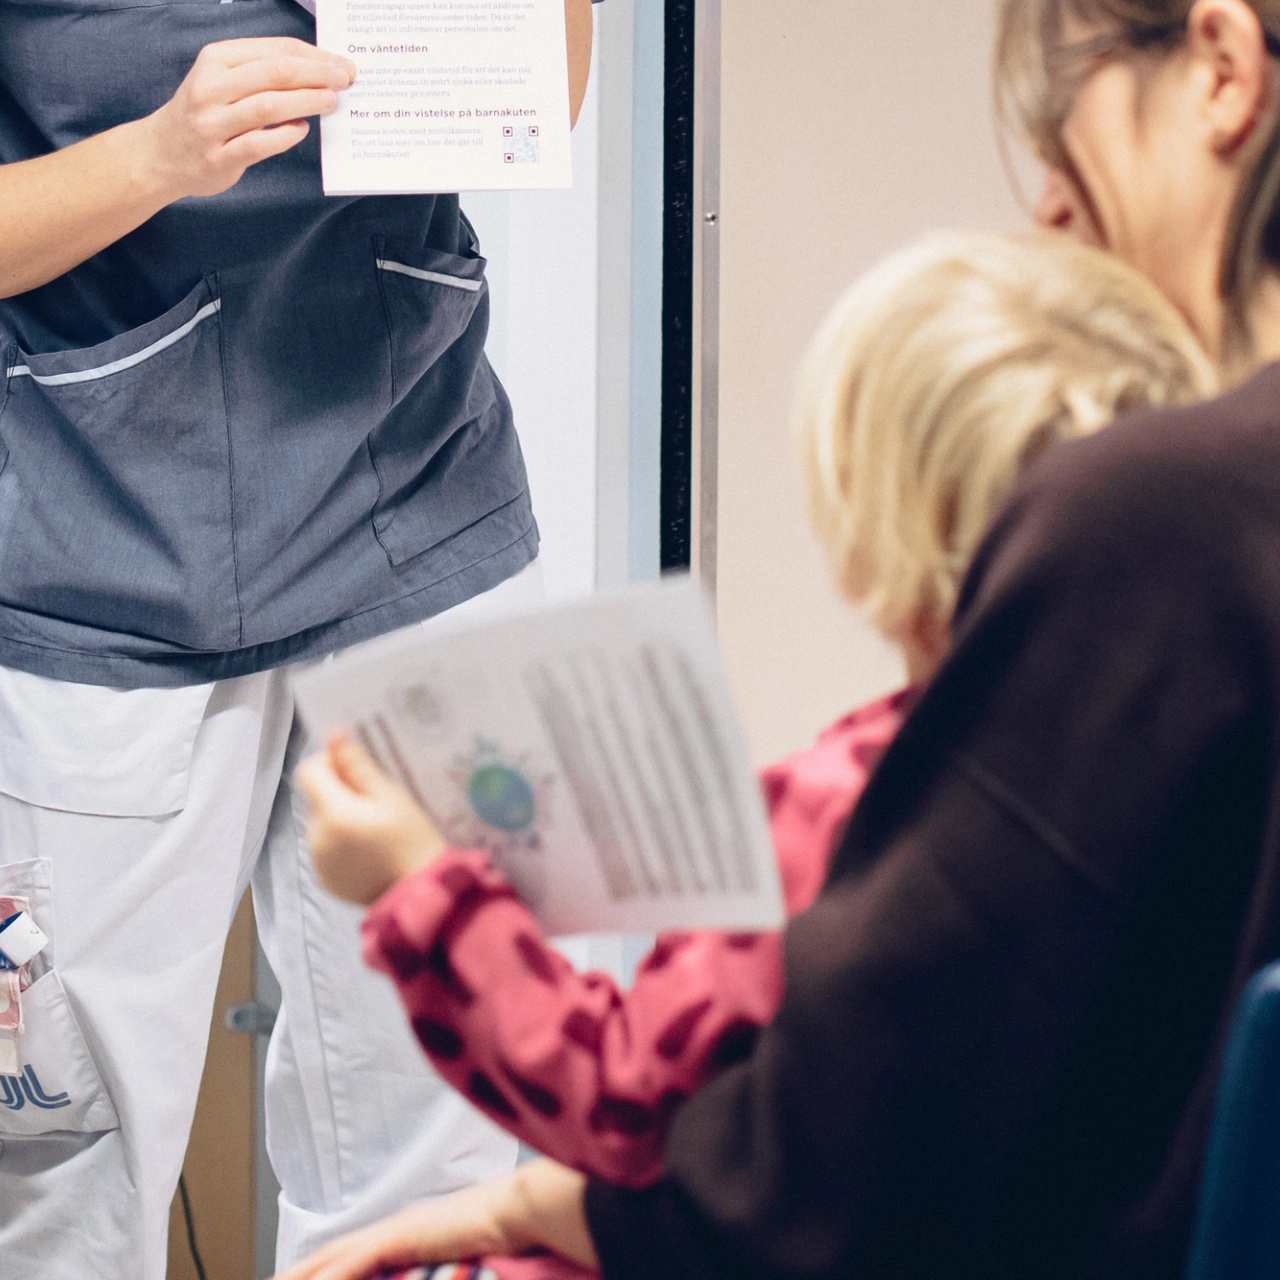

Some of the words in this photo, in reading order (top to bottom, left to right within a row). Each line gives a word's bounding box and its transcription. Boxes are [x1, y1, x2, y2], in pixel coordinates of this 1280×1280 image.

[348, 44, 366, 53] Om
[370, 44, 428, 53] väntetiden
[350, 109, 370, 118] Mer
[373, 110, 391, 118] om
[394, 109, 411, 118] din
[414, 108, 455, 118] vistelse
[458, 108, 472, 119] på
[475, 108, 536, 117] barnakuten
